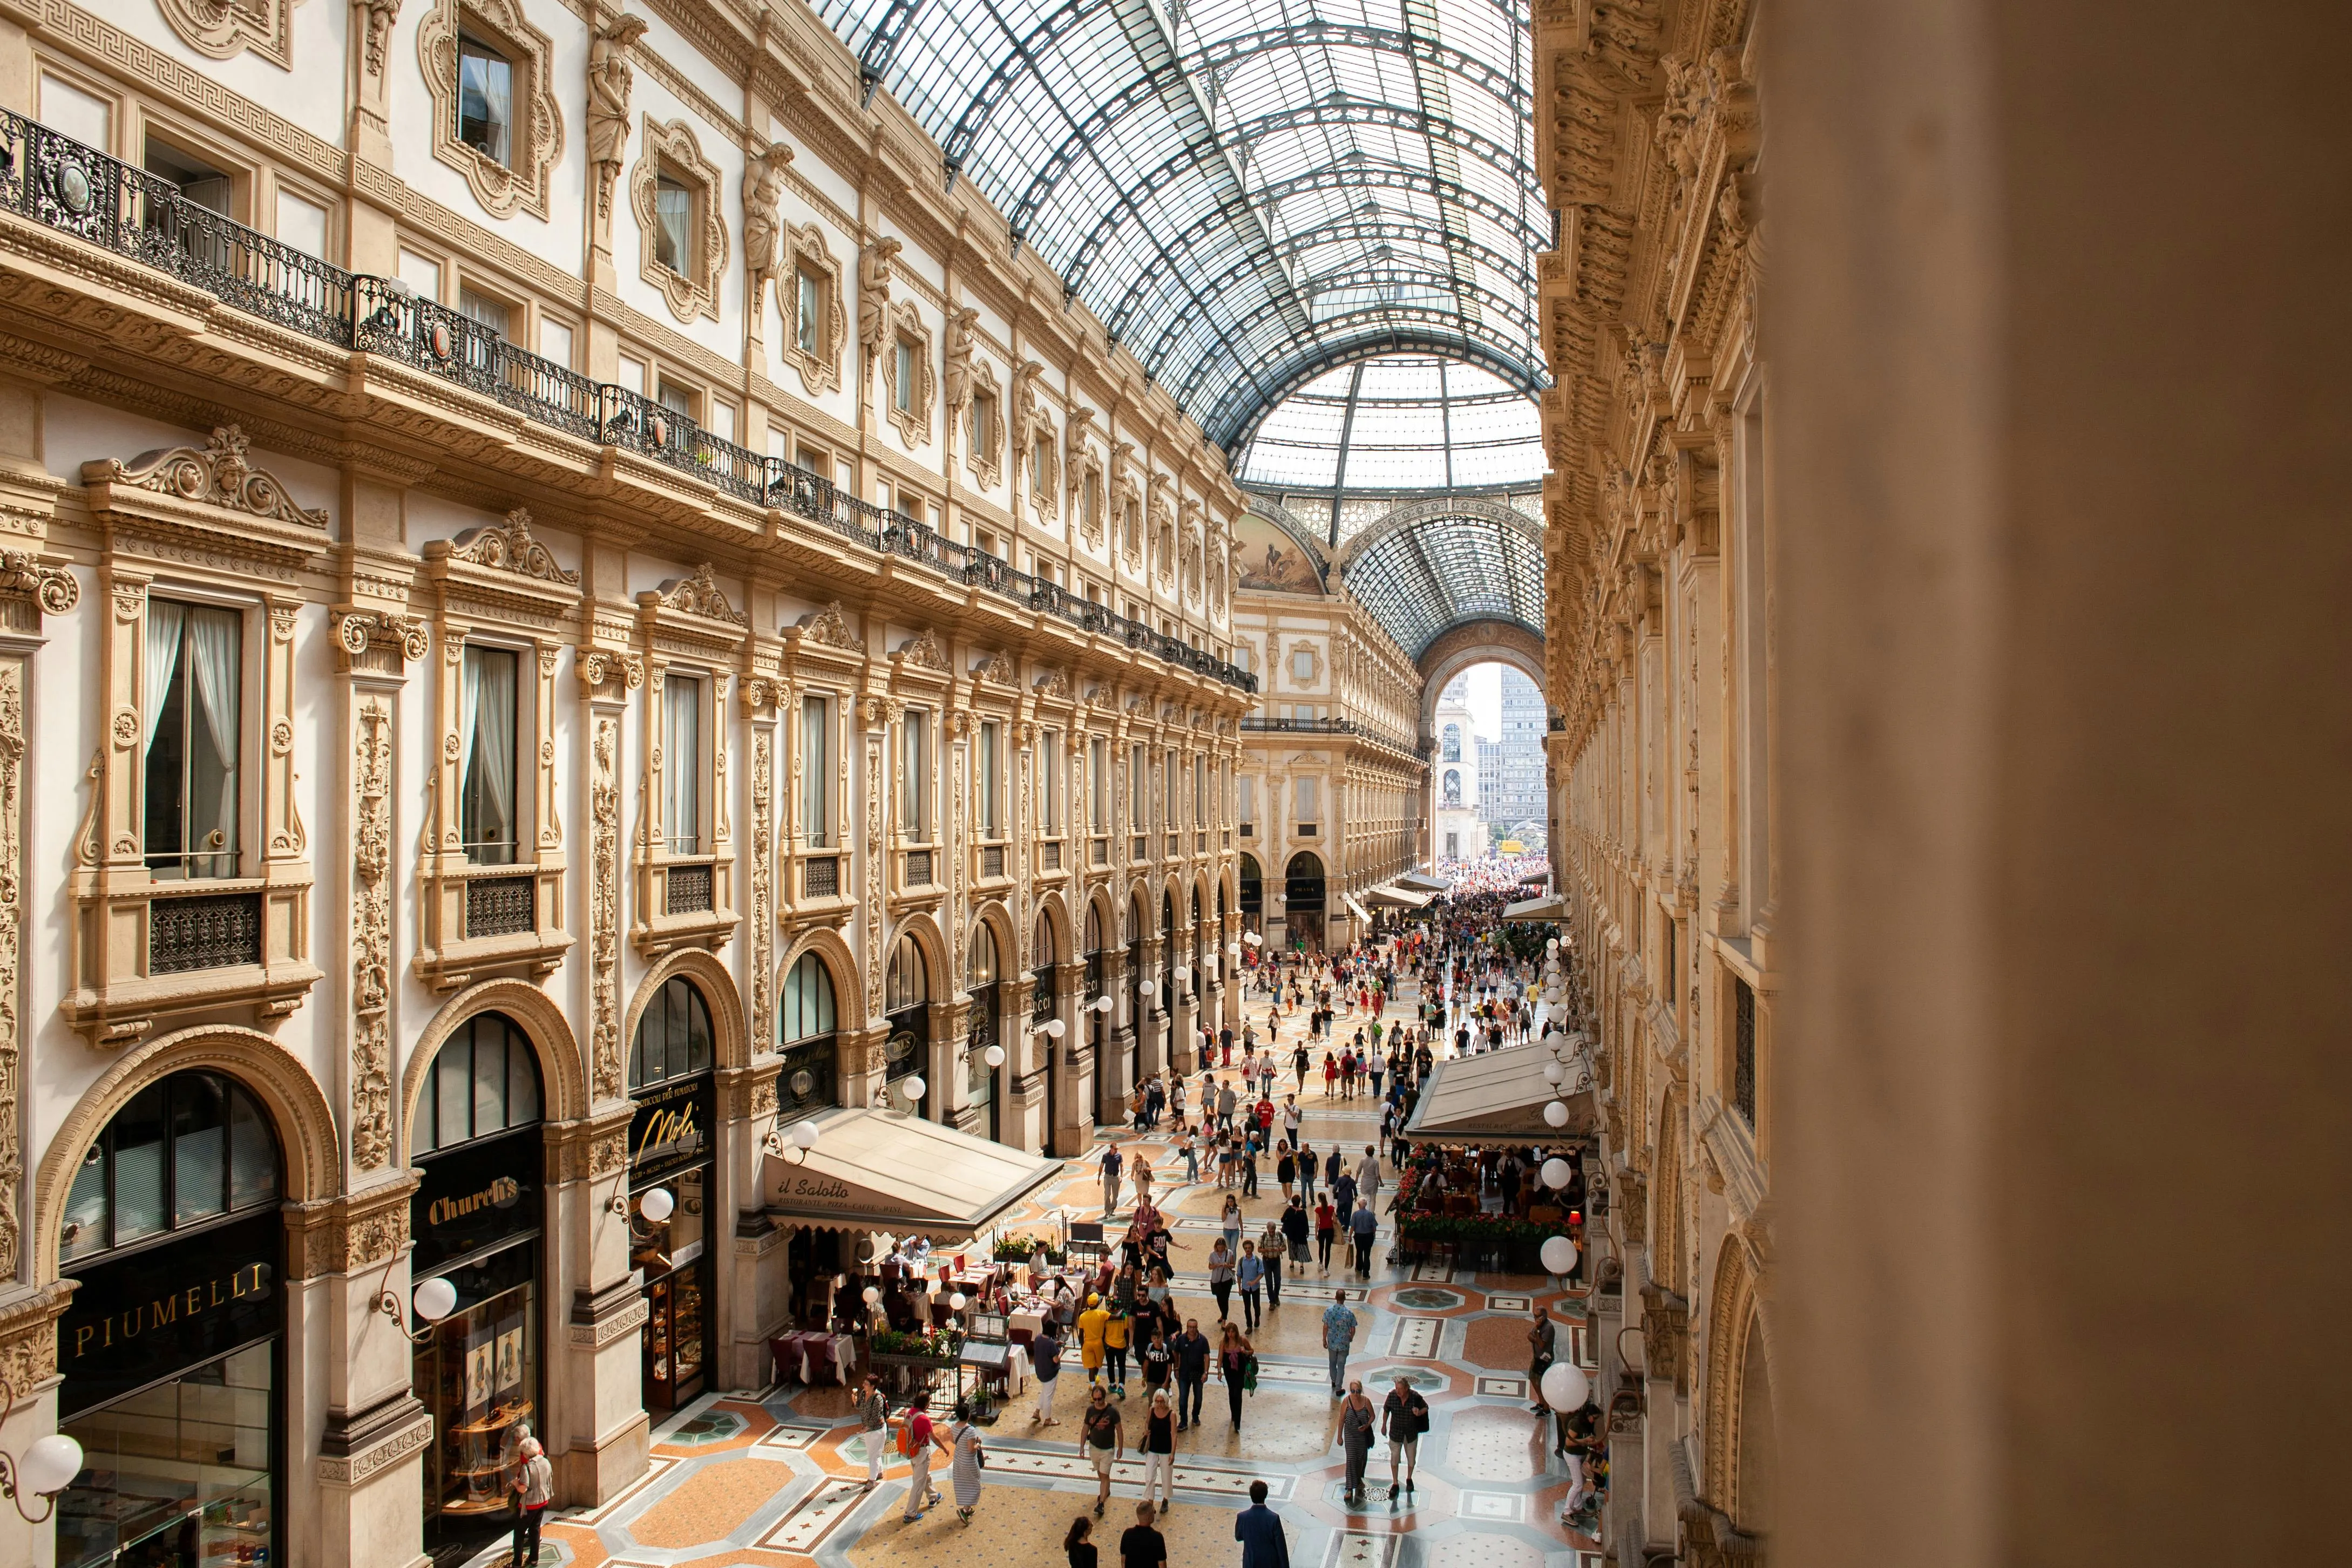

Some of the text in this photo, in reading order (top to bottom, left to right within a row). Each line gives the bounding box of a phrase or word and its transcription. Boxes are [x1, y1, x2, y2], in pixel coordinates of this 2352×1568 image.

[637, 1094, 661, 1108] RTICOLI
[778, 1177, 849, 1198] il Salotto
[429, 1176, 517, 1225] Church's
[778, 1197, 822, 1206] RISTORANTE
[883, 1205, 902, 1214] WINE
[1154, 1235, 1167, 1247] 501
[74, 1264, 263, 1359] PIUMELLI
